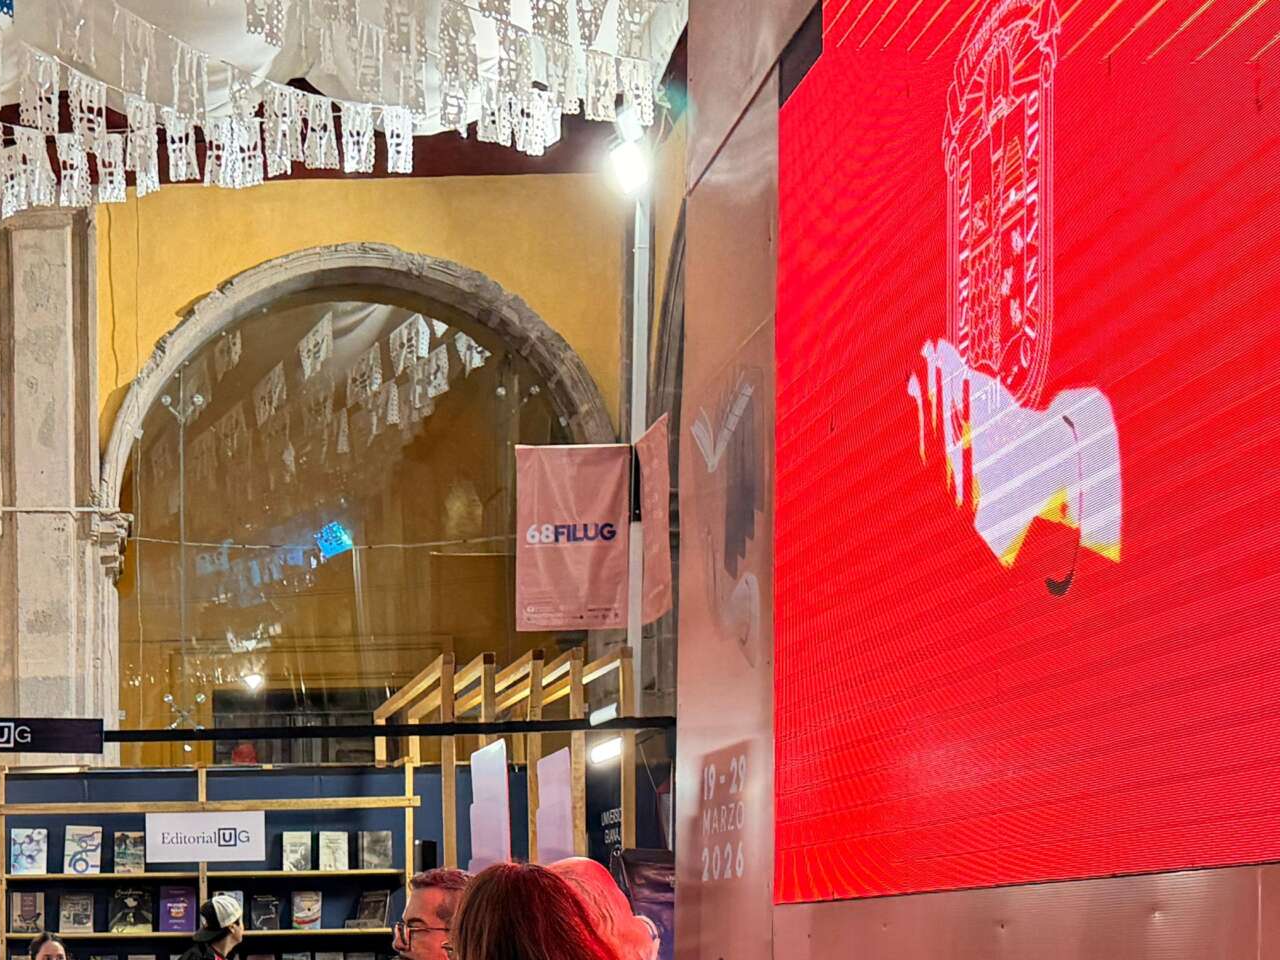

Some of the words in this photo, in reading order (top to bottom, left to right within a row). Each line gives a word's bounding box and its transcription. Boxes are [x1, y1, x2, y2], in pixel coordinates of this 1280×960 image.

[702, 801, 746, 836] MARZO
[160, 830, 217, 846] Editorial
[702, 841, 745, 882] 2026
